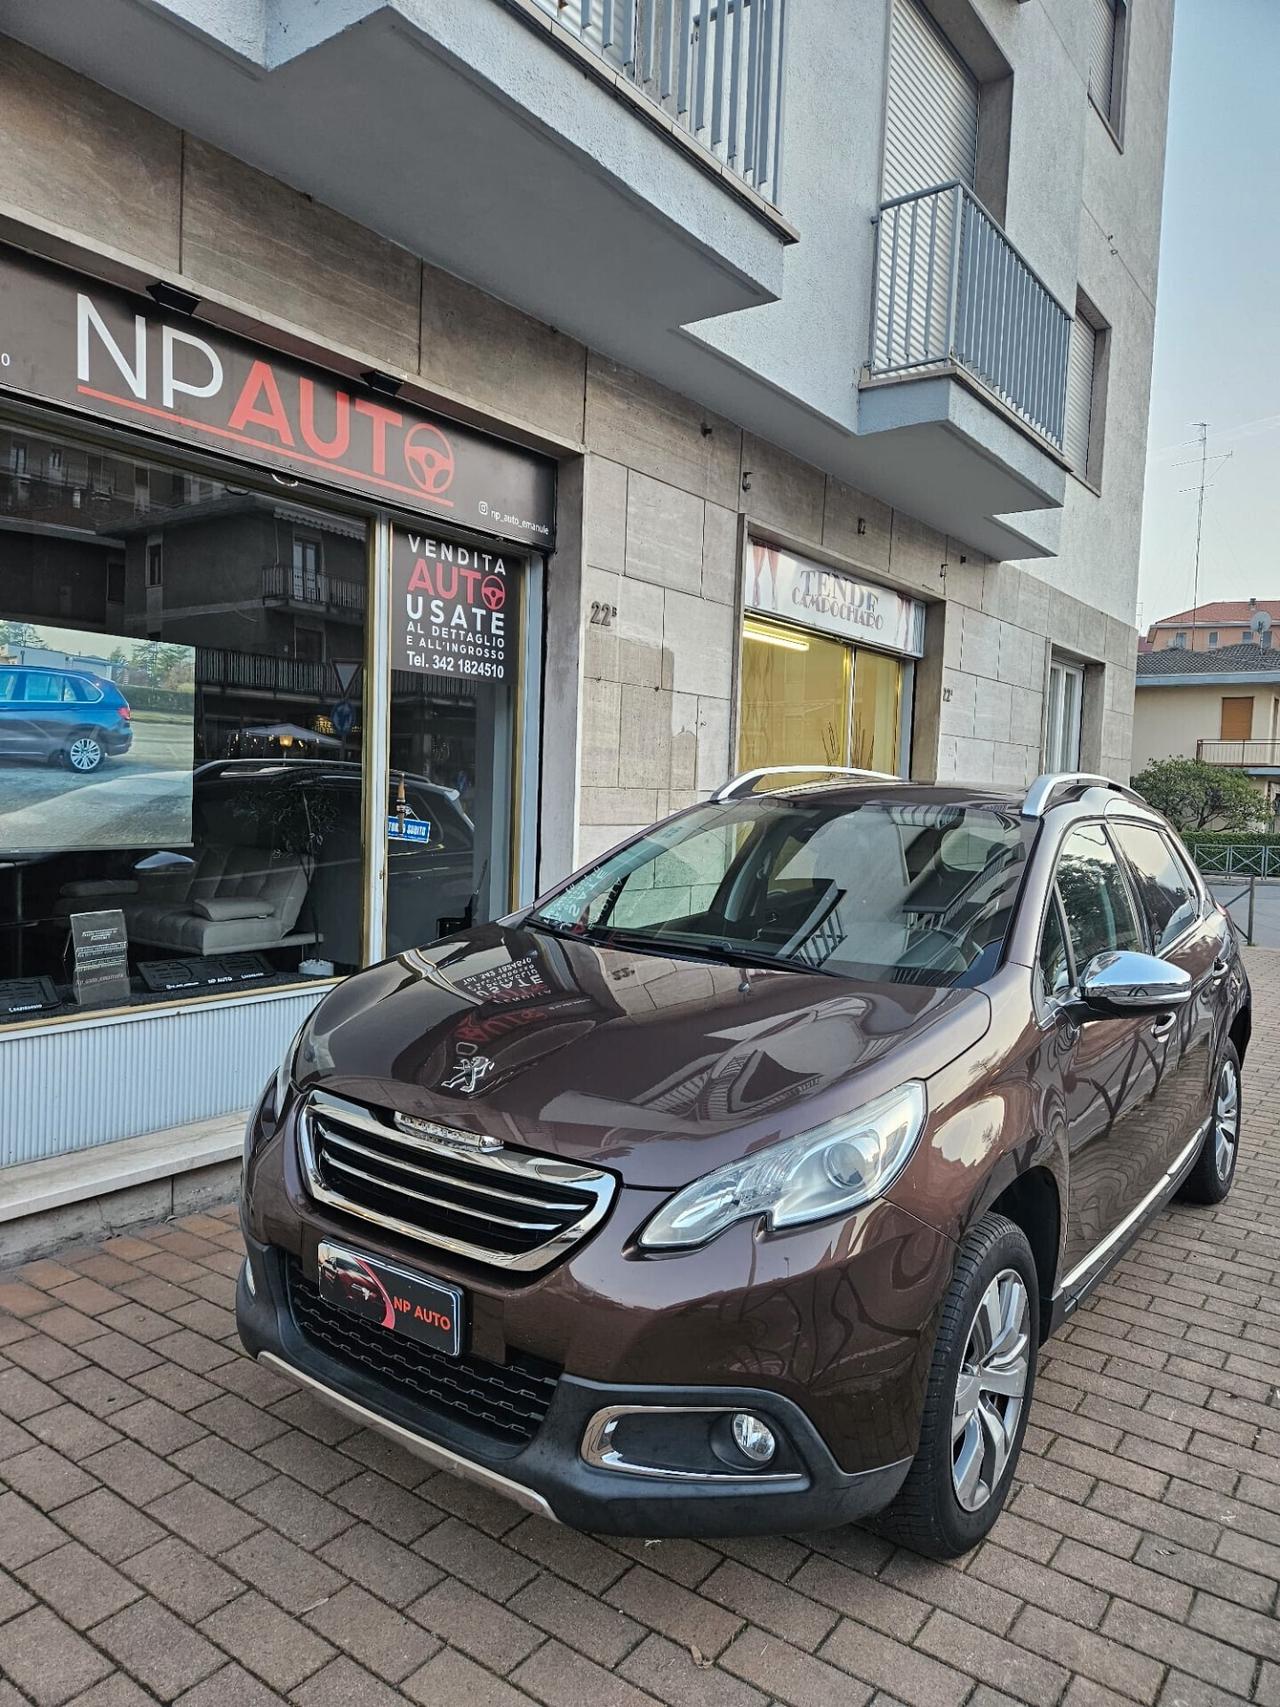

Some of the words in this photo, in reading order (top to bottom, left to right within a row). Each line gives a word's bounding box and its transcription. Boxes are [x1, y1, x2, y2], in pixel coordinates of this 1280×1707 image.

[407, 533, 507, 576] VENDITA
[406, 593, 505, 636] USATE
[406, 635, 414, 646] E
[418, 637, 505, 660] ALL'INGROSSO
[407, 621, 425, 634] AL
[432, 625, 505, 648] DETTAGLIO
[406, 650, 429, 668] Tel.
[432, 654, 454, 672] 342
[459, 659, 505, 679] 1824510
[393, 1295, 411, 1313] NP
[414, 1305, 451, 1331] AUTO
